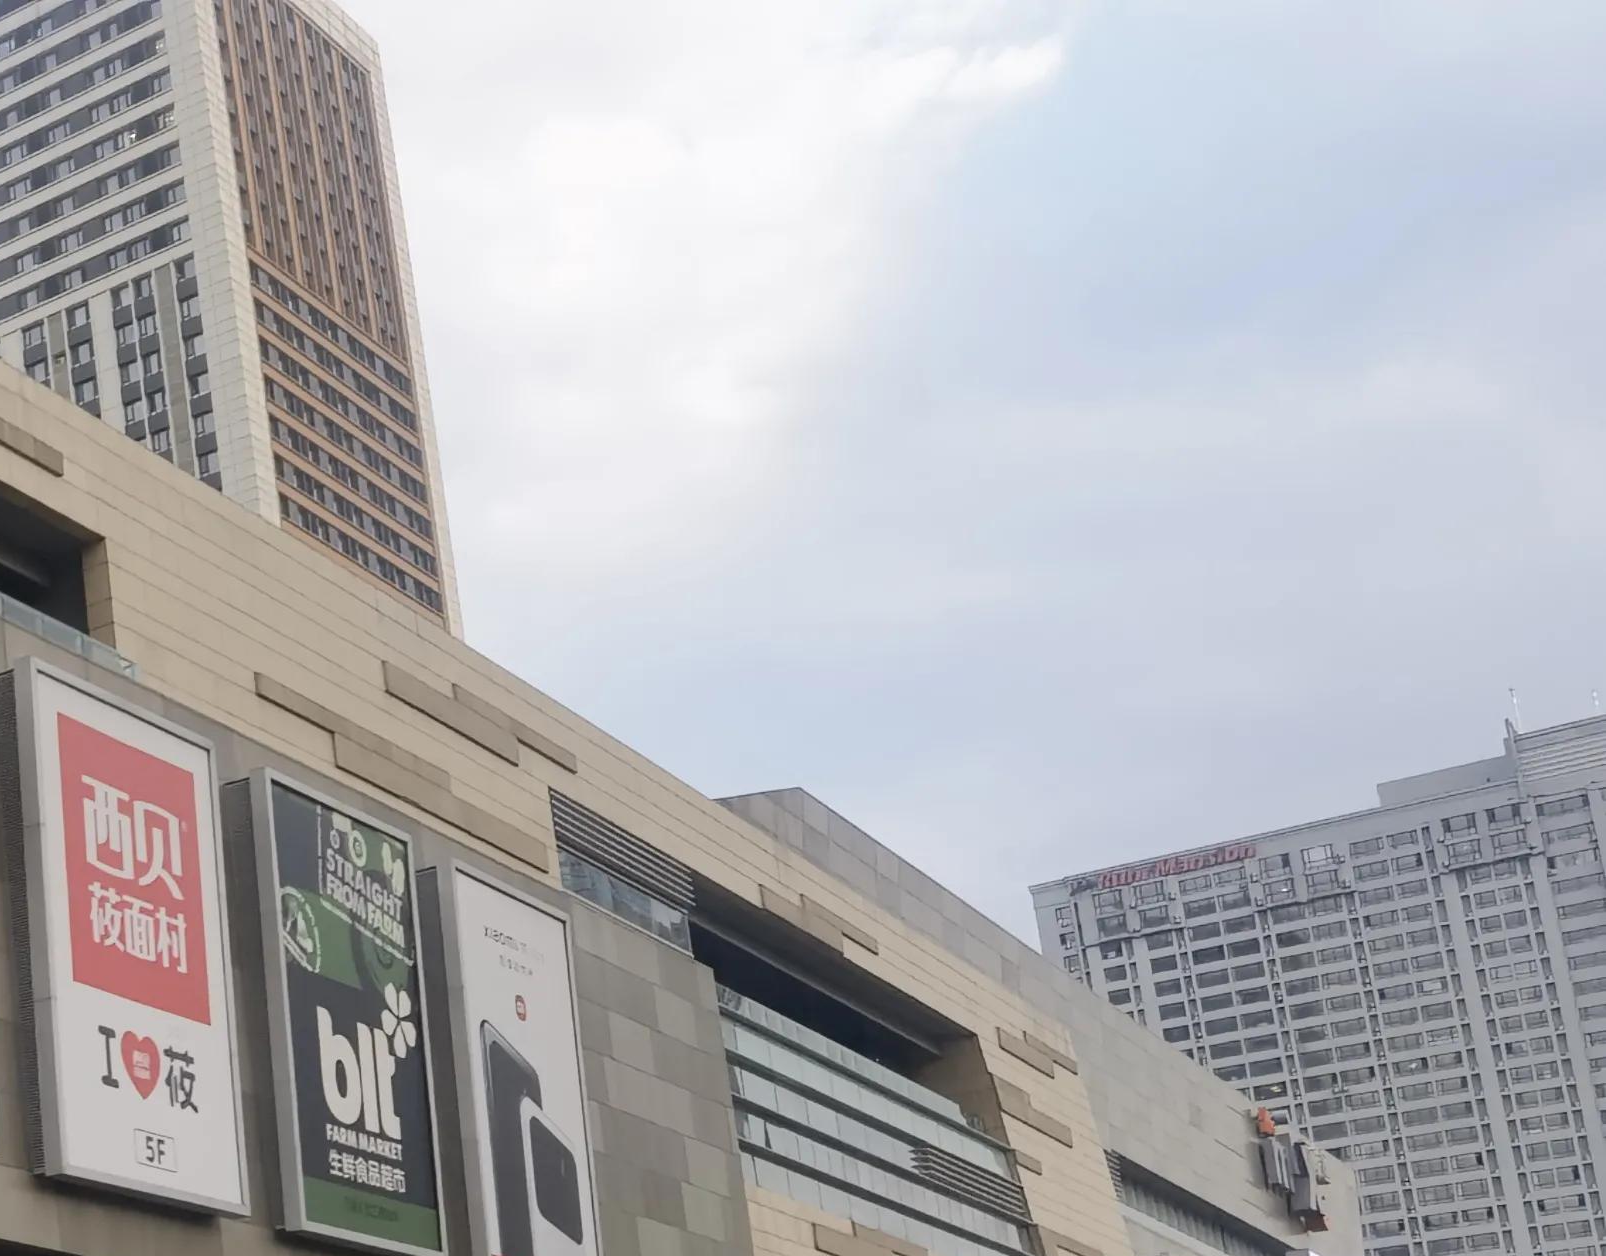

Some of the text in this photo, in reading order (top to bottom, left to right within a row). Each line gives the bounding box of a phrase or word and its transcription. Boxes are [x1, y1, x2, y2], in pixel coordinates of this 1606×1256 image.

[81, 774, 184, 900] 西贝
[326, 848, 403, 921] STRAIGHT
[87, 881, 188, 974] 莜面村
[145, 1136, 166, 1166] 5F
[326, 1123, 403, 1161] FARM MARKET
